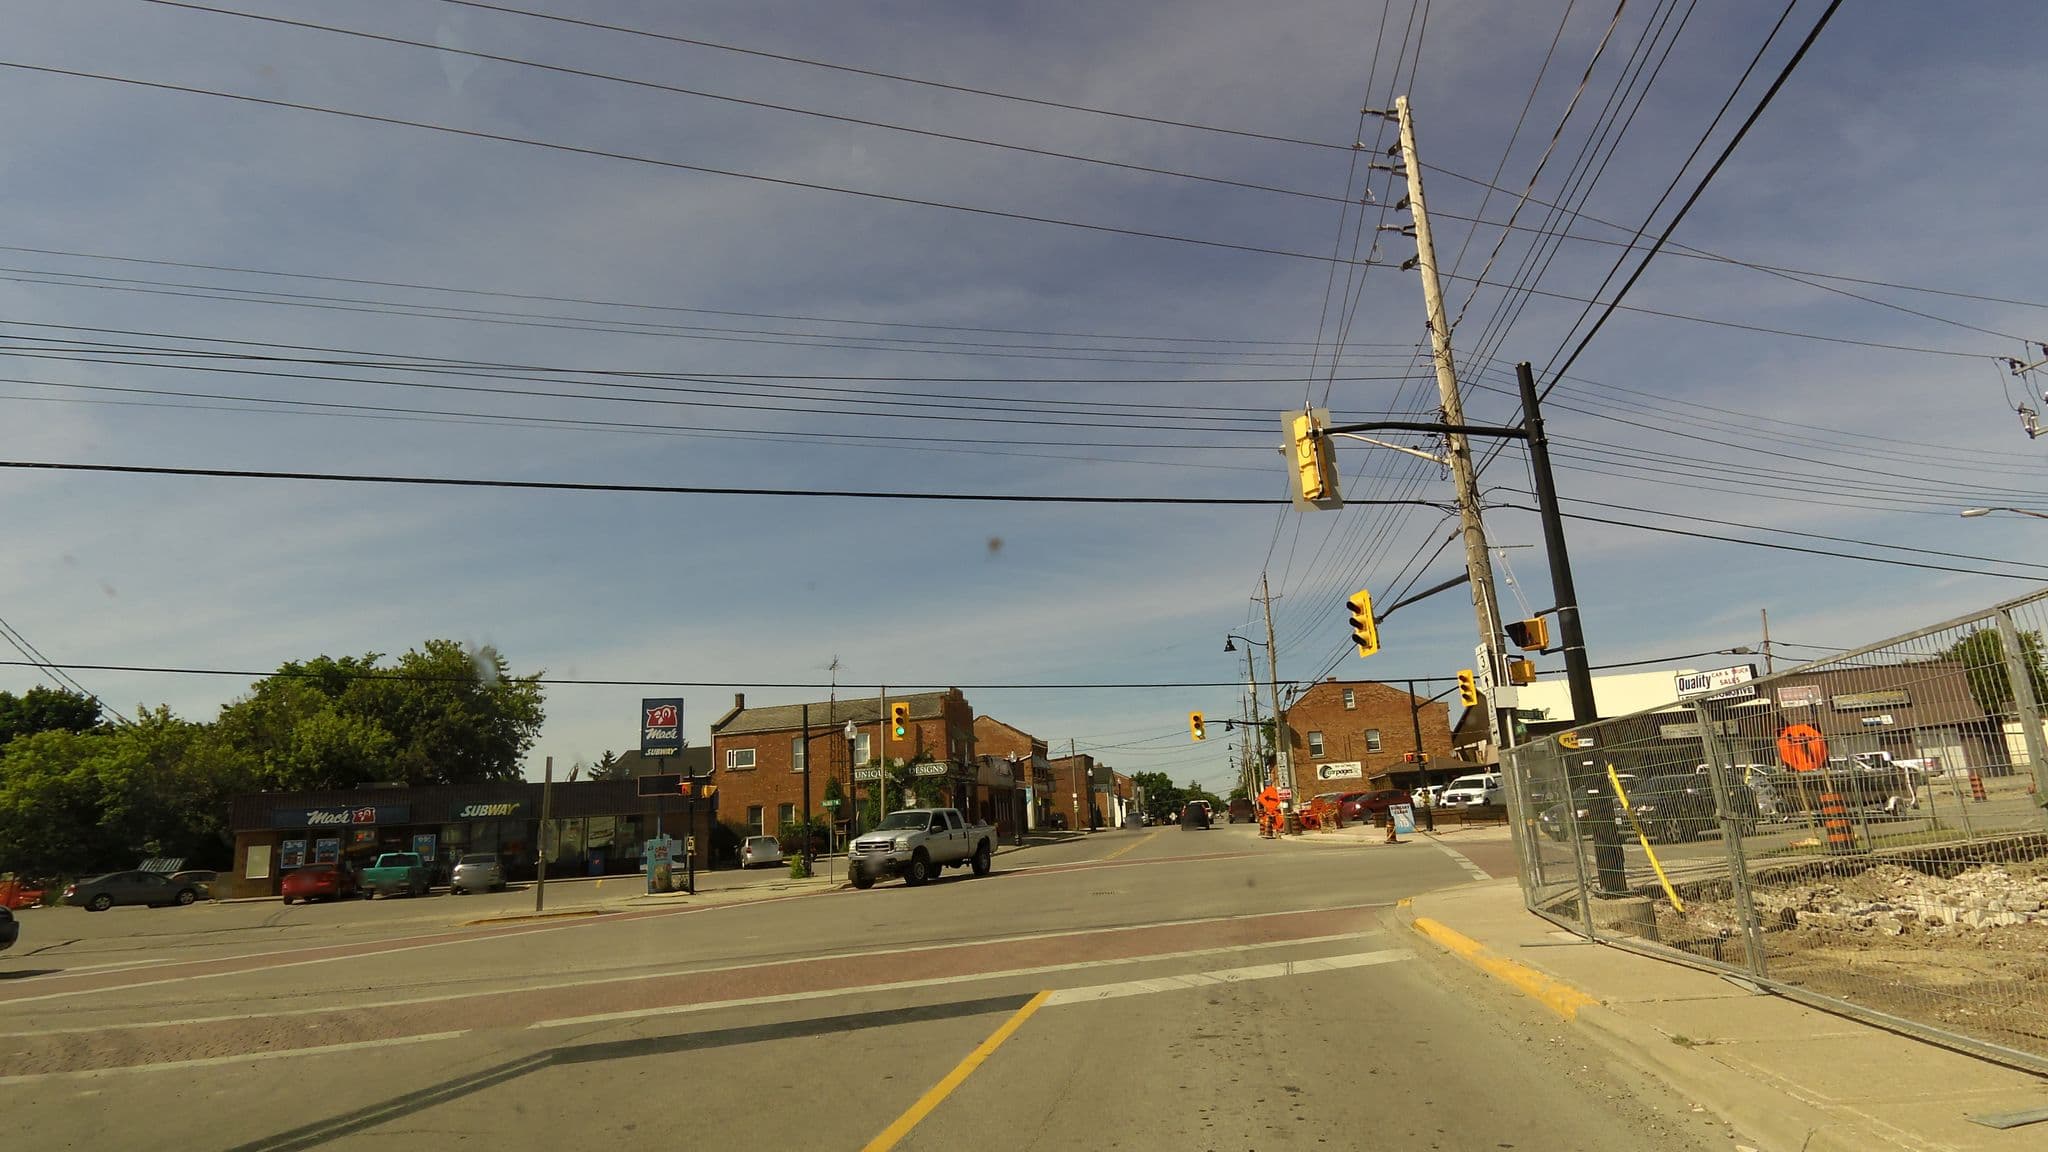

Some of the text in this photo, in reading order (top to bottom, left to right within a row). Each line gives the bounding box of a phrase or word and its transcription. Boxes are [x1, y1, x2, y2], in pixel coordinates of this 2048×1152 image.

[1480, 655, 1486, 669] 3
[1679, 674, 1711, 693] Quality
[645, 728, 678, 740] Mac's
[644, 748, 678, 756] SUBWAY
[908, 764, 944, 775] DESIGNS
[306, 810, 351, 825] Mac's
[459, 803, 521, 818] SUBWAY
